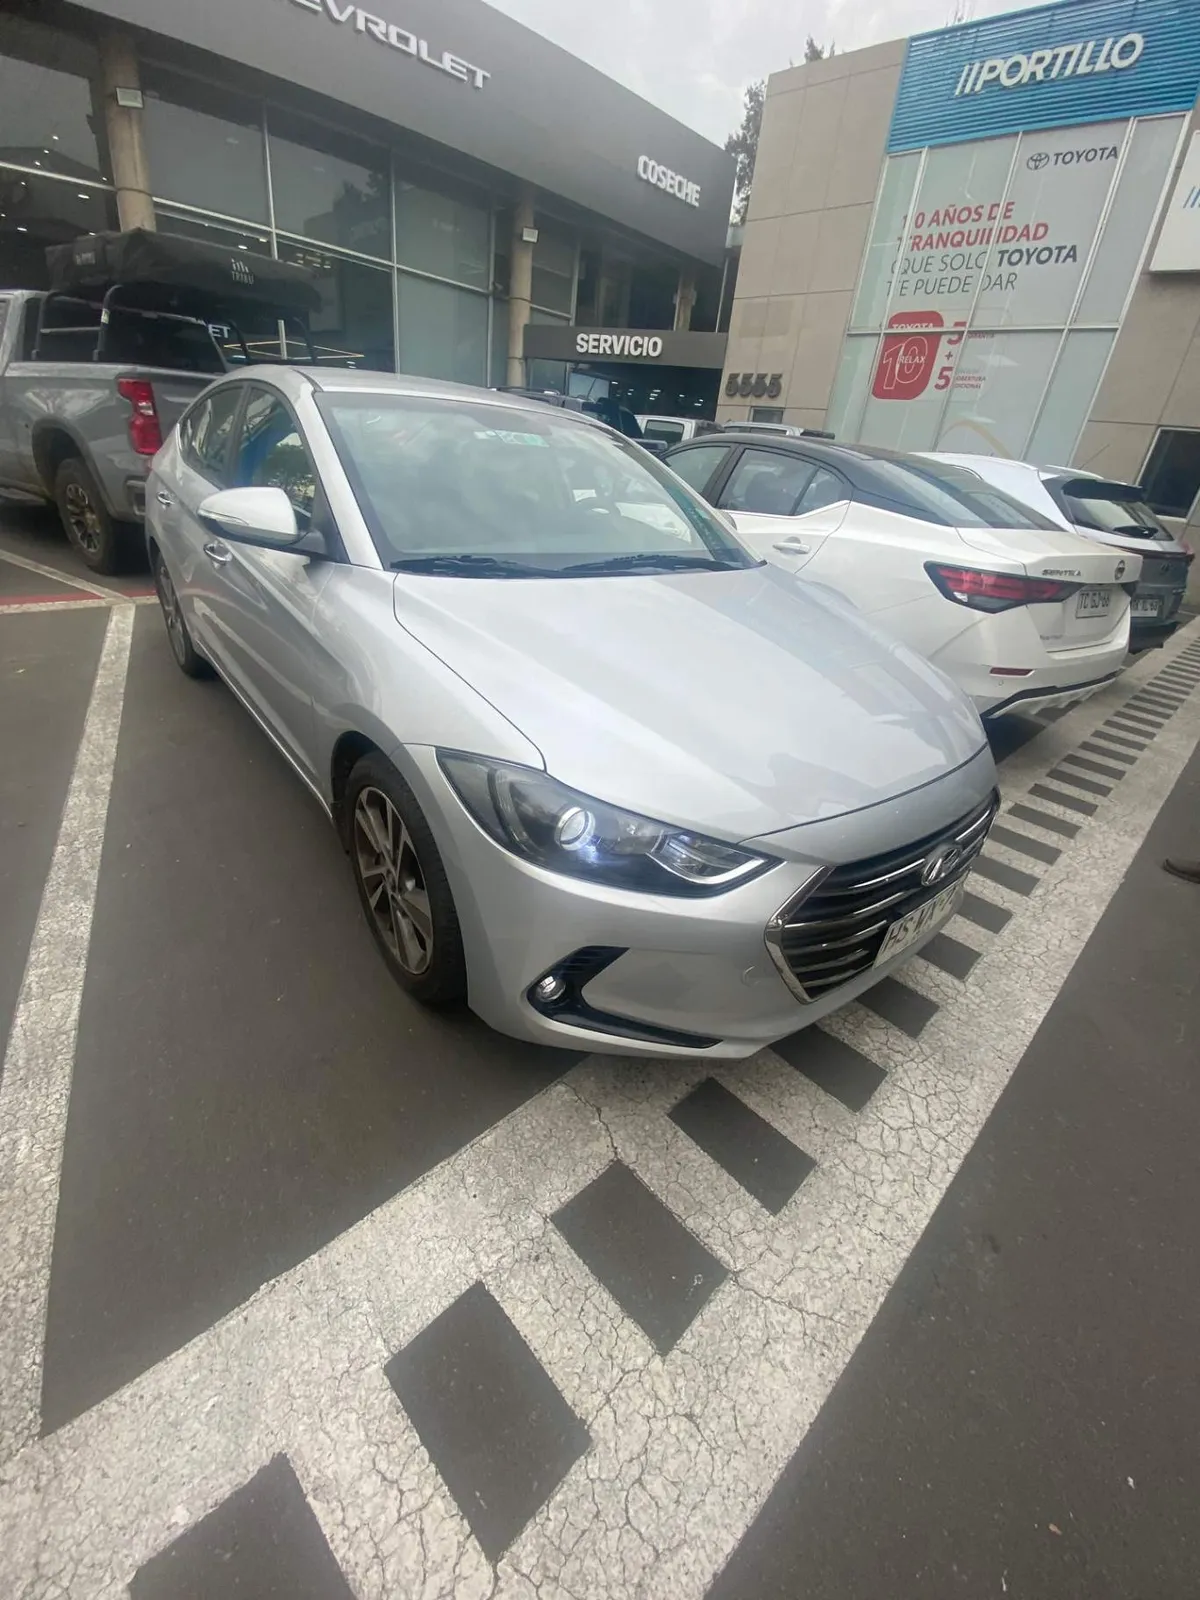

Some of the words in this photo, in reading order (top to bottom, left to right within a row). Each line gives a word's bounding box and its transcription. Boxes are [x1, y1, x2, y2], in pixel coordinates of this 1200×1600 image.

[1053, 146, 1118, 166] TOYOTA
[637, 155, 701, 207] COSECHE
[927, 204, 984, 228] AÑOS
[987, 201, 1015, 221] DE
[891, 255, 935, 275] QUE
[997, 245, 1077, 268] TOYOTA
[913, 275, 973, 296] PUEDE
[575, 333, 663, 357] SERVICIO
[899, 355, 926, 364] RELAX
[934, 366, 954, 390] 5
